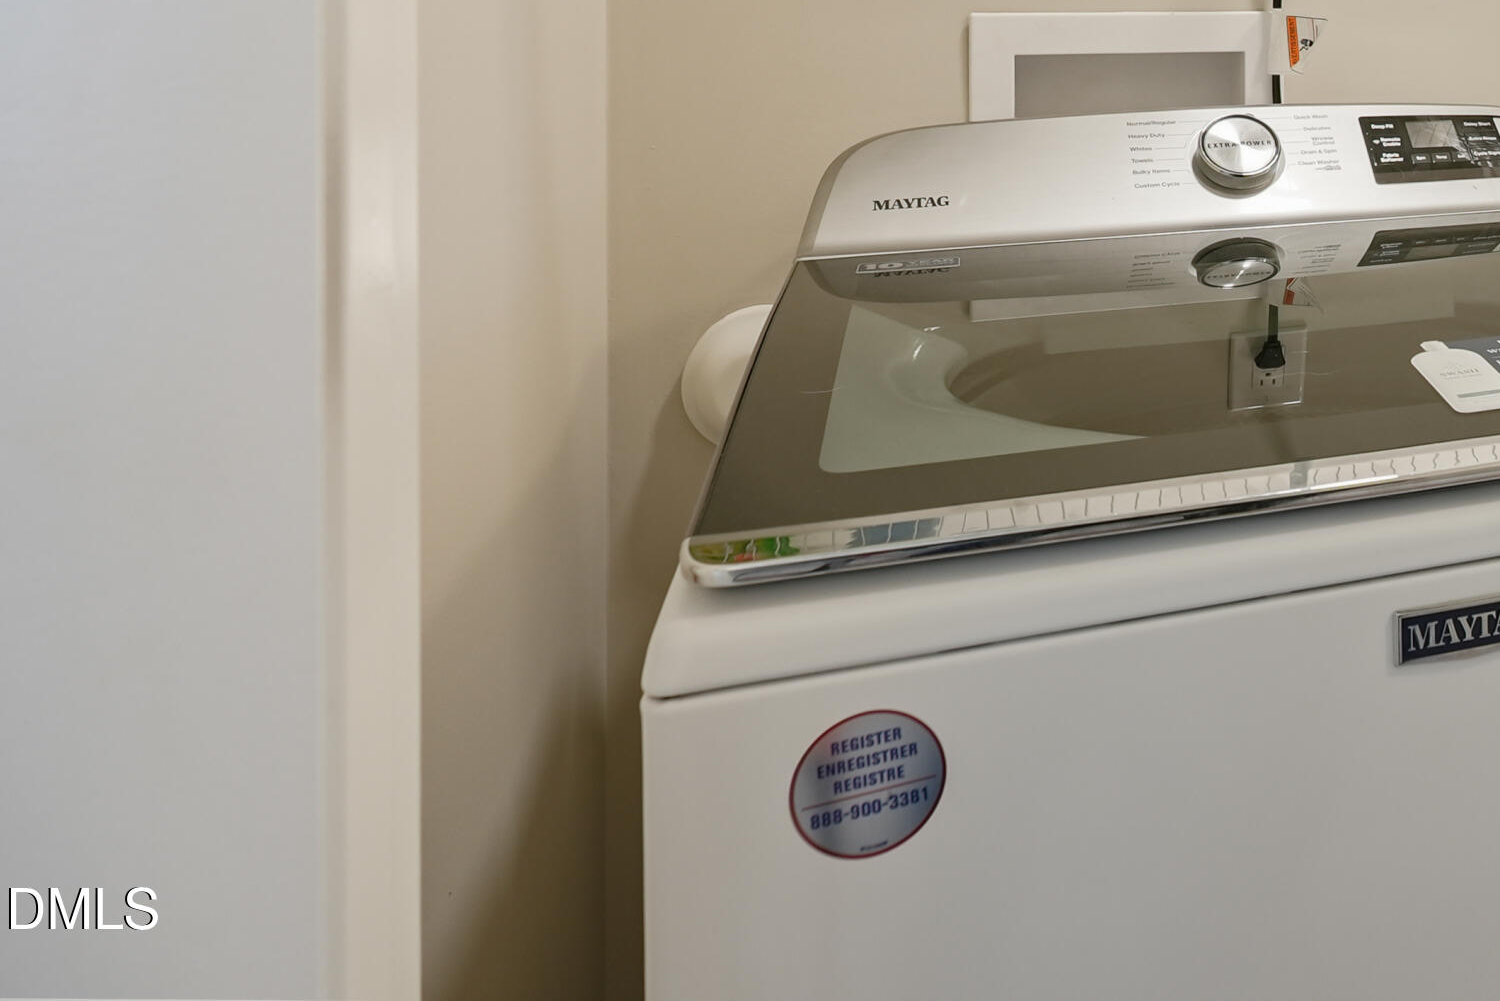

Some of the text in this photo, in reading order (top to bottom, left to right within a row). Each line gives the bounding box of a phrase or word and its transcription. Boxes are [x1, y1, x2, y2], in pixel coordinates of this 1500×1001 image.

[872, 195, 950, 212] MAYTAG
[830, 727, 902, 756] REGISTER
[817, 742, 918, 780] ENREGISTRER
[833, 765, 905, 795] REGISTRE
[810, 786, 929, 830] 888-900-3381
